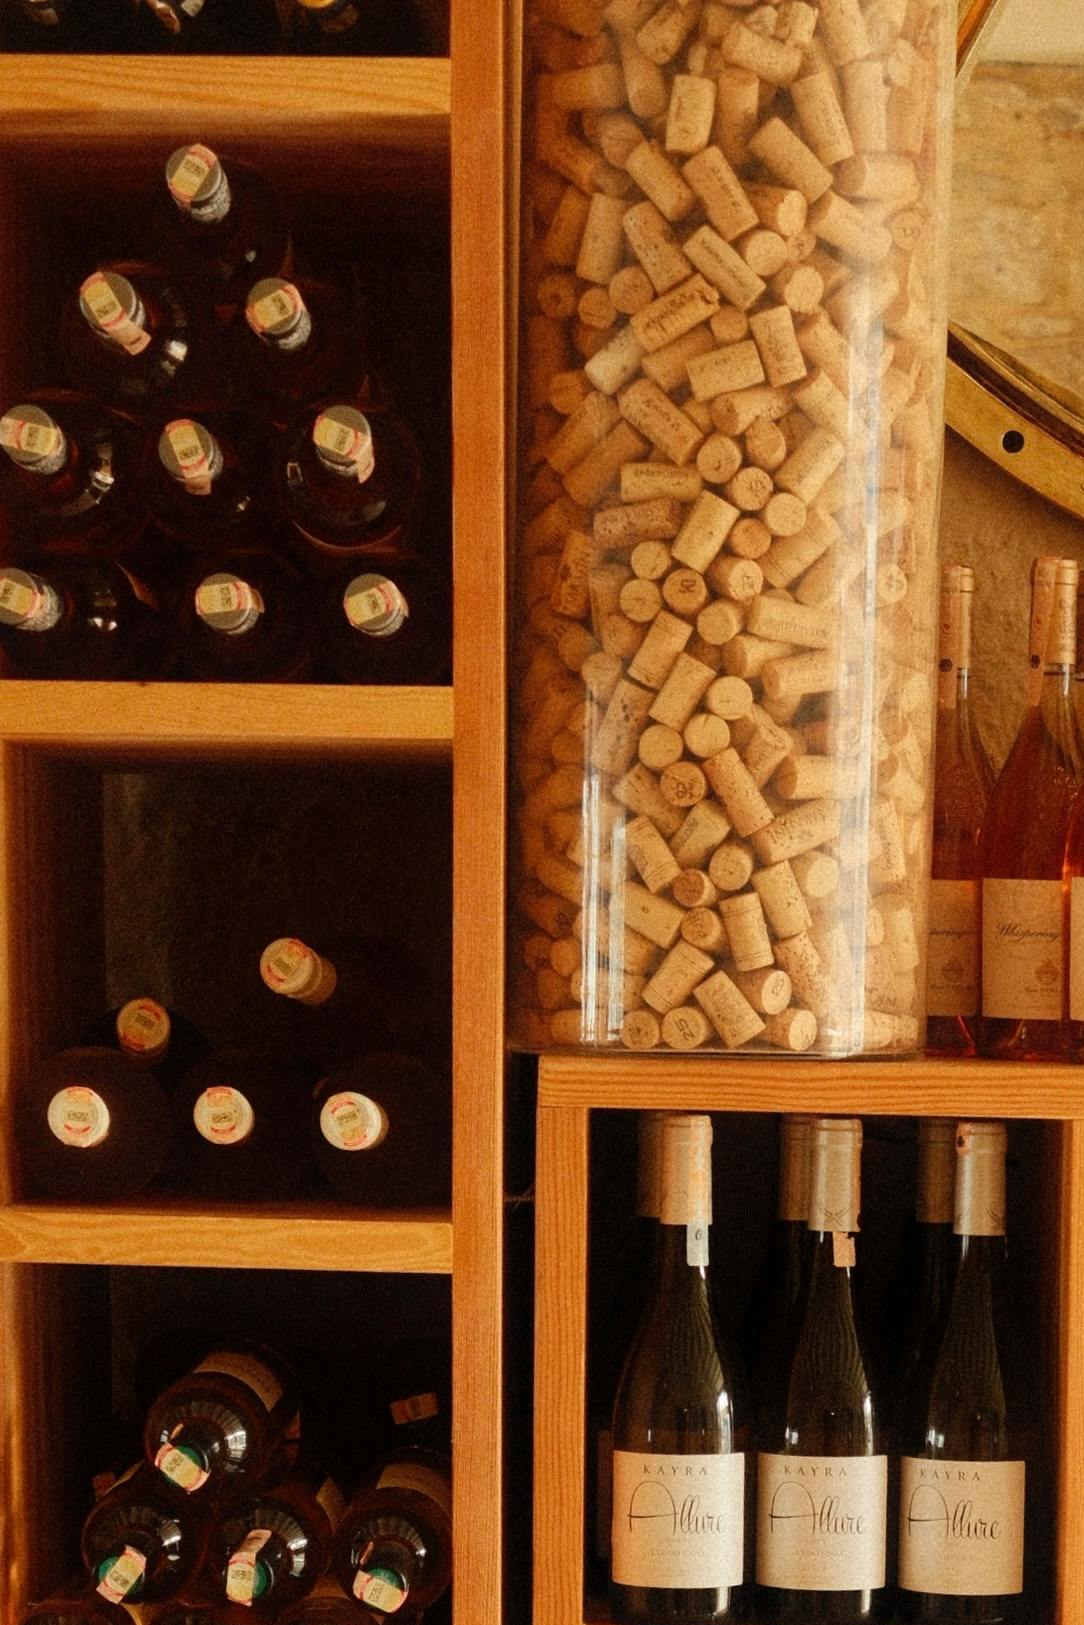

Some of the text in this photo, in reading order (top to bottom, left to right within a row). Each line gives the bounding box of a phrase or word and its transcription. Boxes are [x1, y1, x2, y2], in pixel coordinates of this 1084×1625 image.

[997, 922, 1061, 942] Whispering
[643, 1465, 707, 1476] KAYRA
[784, 1465, 848, 1477] KAYRA
[920, 1469, 981, 1481] KAYRA
[627, 1480, 726, 1535] Allure
[769, 1480, 867, 1536] Allure
[907, 1484, 1001, 1540] Allure
